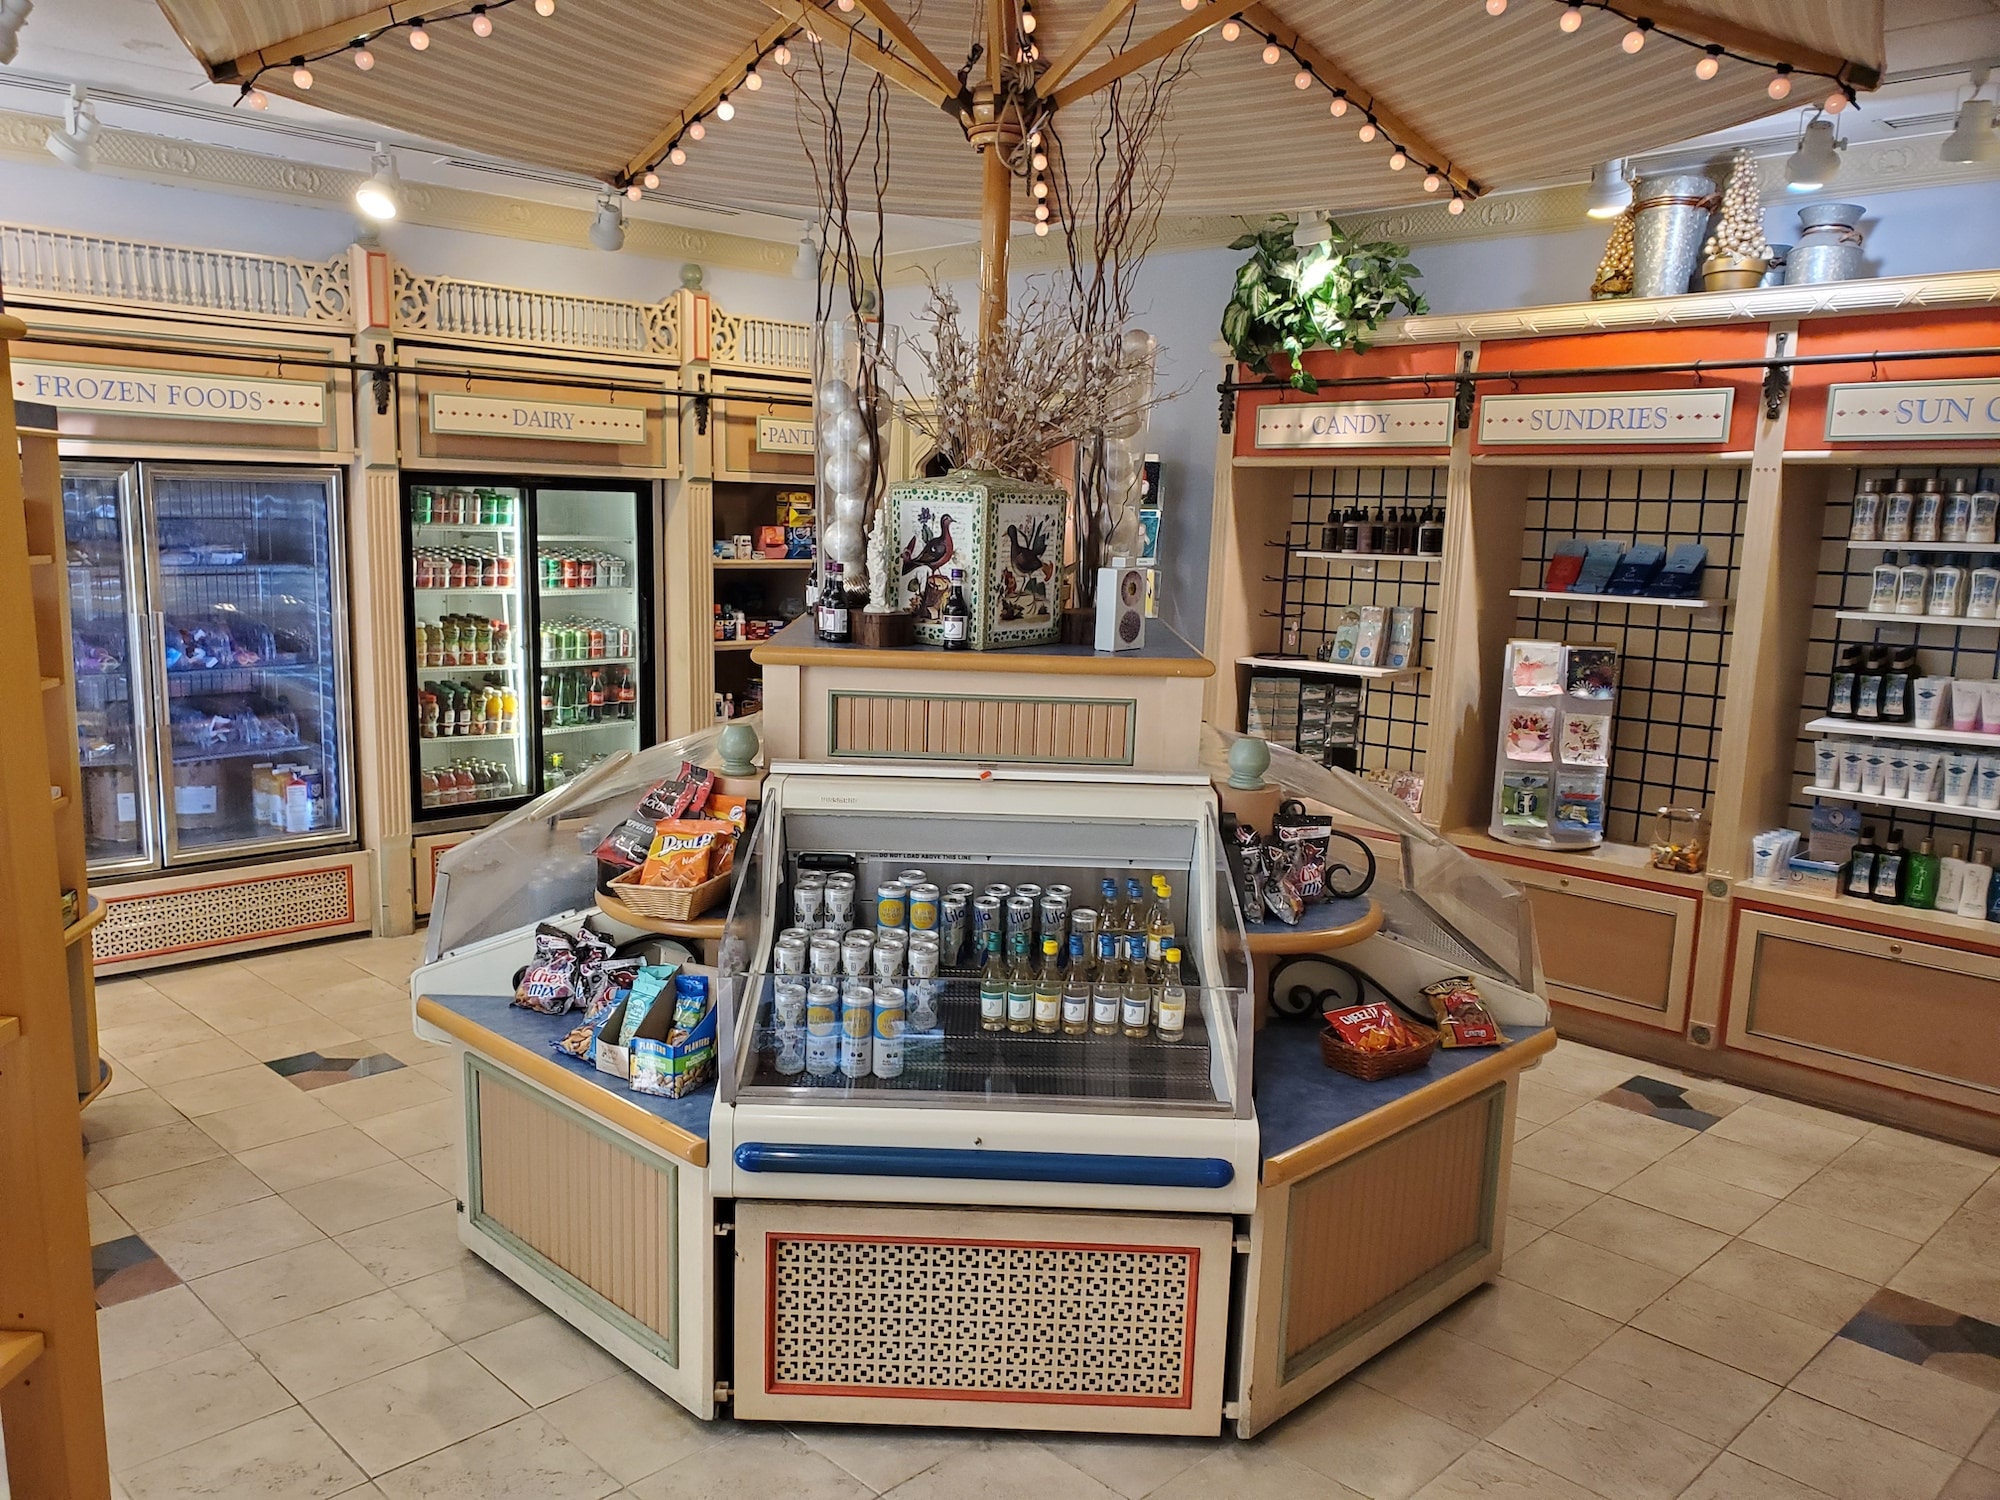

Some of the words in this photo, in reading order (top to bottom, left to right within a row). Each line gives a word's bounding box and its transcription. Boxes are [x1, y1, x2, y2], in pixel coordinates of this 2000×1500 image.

[34, 374, 157, 404] FROZEN
[167, 384, 264, 412] FOODS
[512, 408, 576, 431] DAIRY
[1529, 406, 1669, 431] SUNDRIES
[1895, 397, 1976, 425] SUN
[1311, 413, 1391, 436] CANDY
